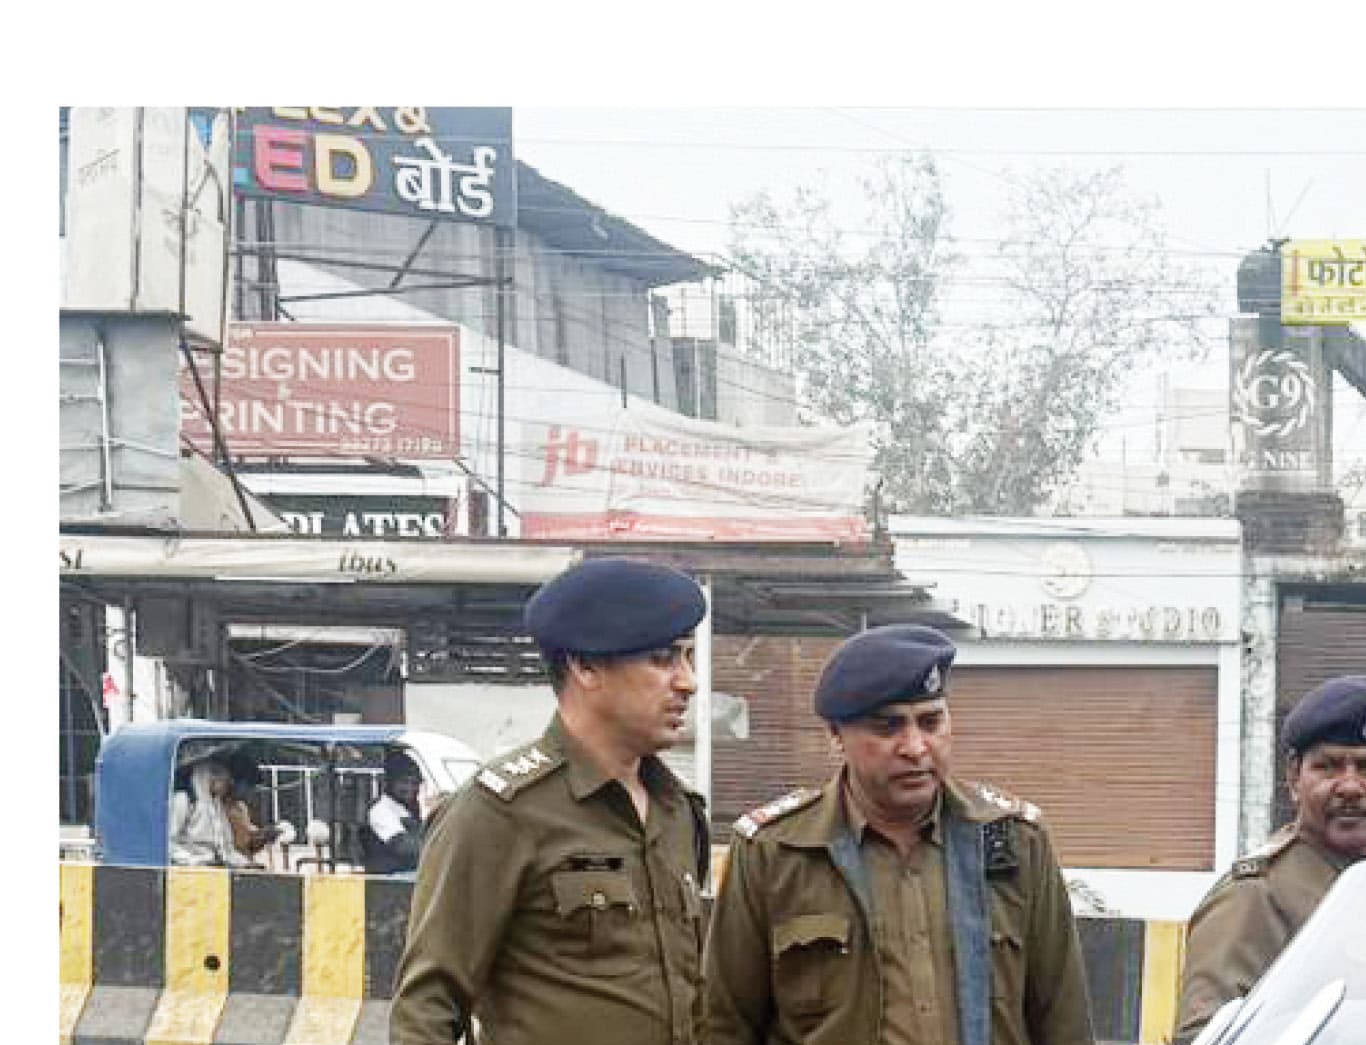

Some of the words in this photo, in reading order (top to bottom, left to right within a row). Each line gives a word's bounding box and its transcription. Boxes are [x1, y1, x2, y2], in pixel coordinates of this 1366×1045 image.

[234, 125, 377, 198] ED
[392, 138, 497, 218] बोर्ड
[200, 346, 417, 382] SIGNING
